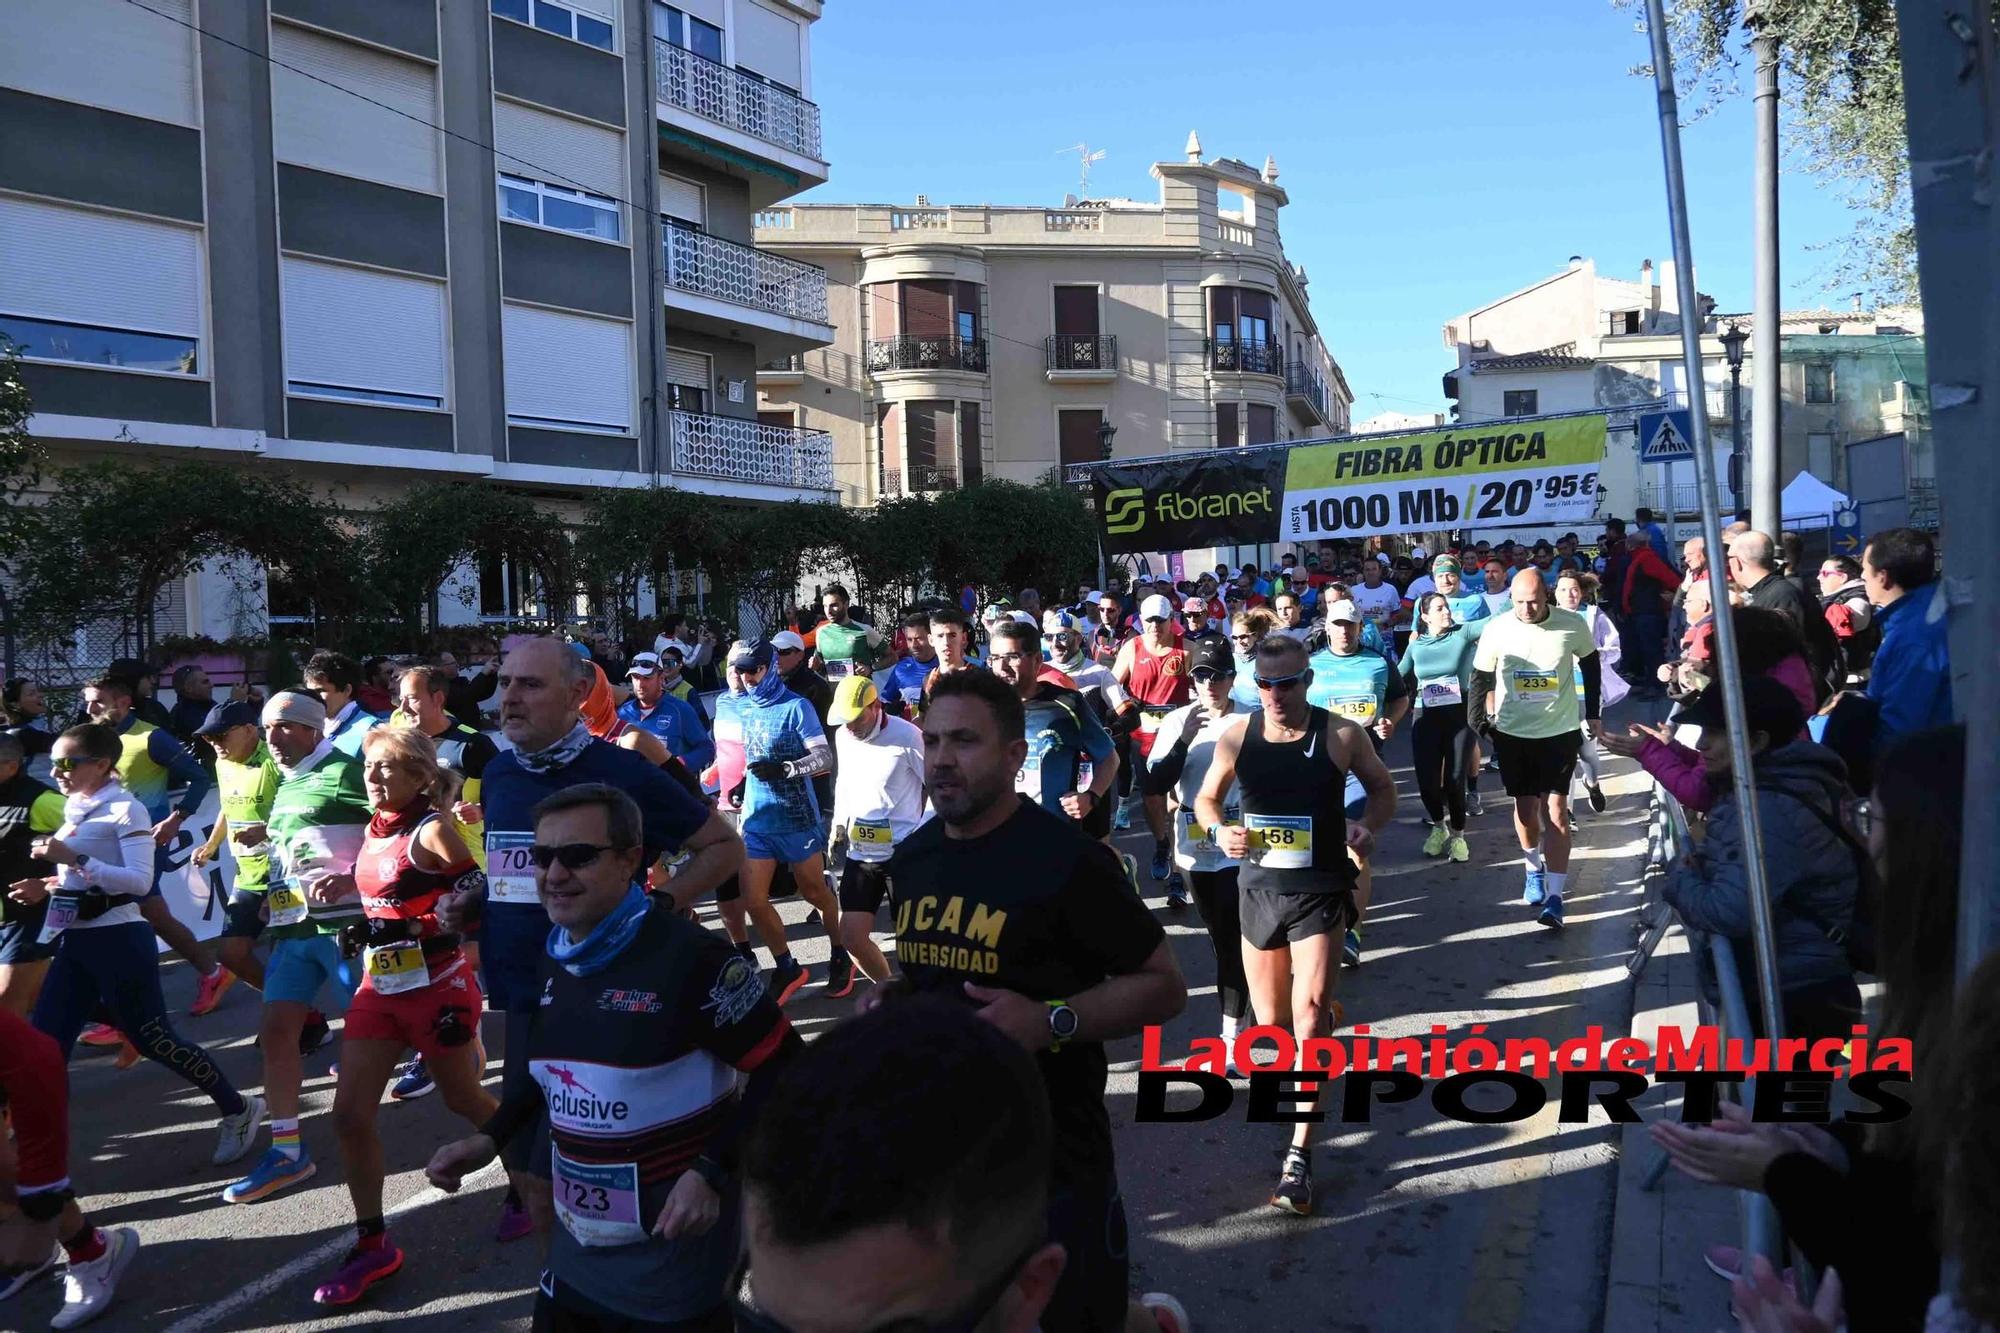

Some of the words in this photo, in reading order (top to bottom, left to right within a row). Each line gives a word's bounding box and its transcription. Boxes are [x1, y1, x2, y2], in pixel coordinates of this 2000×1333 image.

[1335, 445, 1422, 478] FIBRA
[1434, 432, 1546, 469] ÓPTICA
[1155, 487, 1272, 521] fibranet
[1302, 494, 1390, 531] 1000
[1399, 488, 1458, 524] Mb
[1291, 506, 1300, 533] HASTA
[1523, 679, 1548, 687] 233
[1342, 703, 1365, 713] 135
[859, 827, 875, 839] 95
[1260, 829, 1294, 844] 158
[273, 889, 291, 905] 157
[896, 896, 1007, 949] UCAM
[372, 951, 402, 970] 151
[561, 1177, 610, 1211] 723
